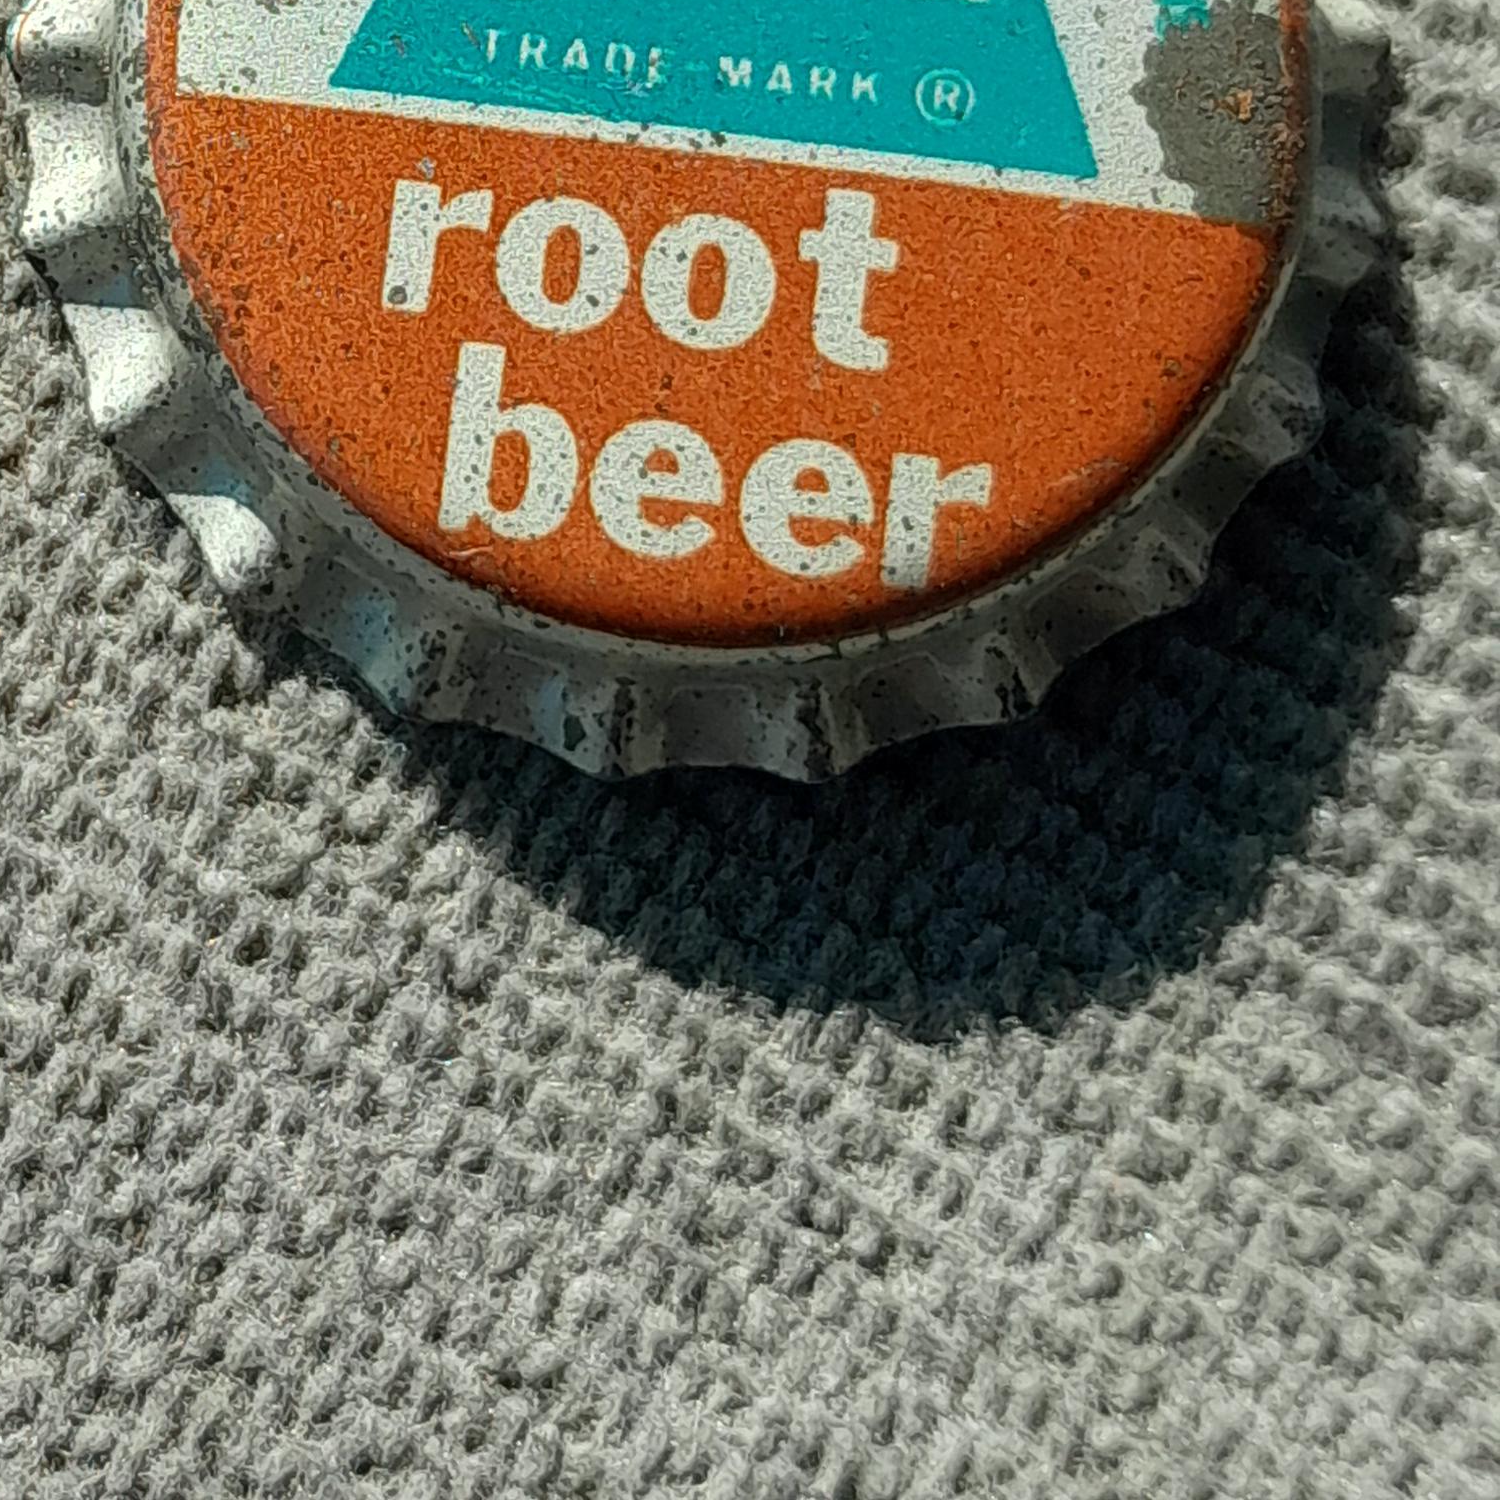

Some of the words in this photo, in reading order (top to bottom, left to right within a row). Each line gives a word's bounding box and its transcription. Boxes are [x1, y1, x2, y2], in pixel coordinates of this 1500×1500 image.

[485, 26, 666, 90] TRADE
[717, 54, 882, 103] MARK
[381, 178, 900, 373] root
[437, 341, 993, 591] beer
